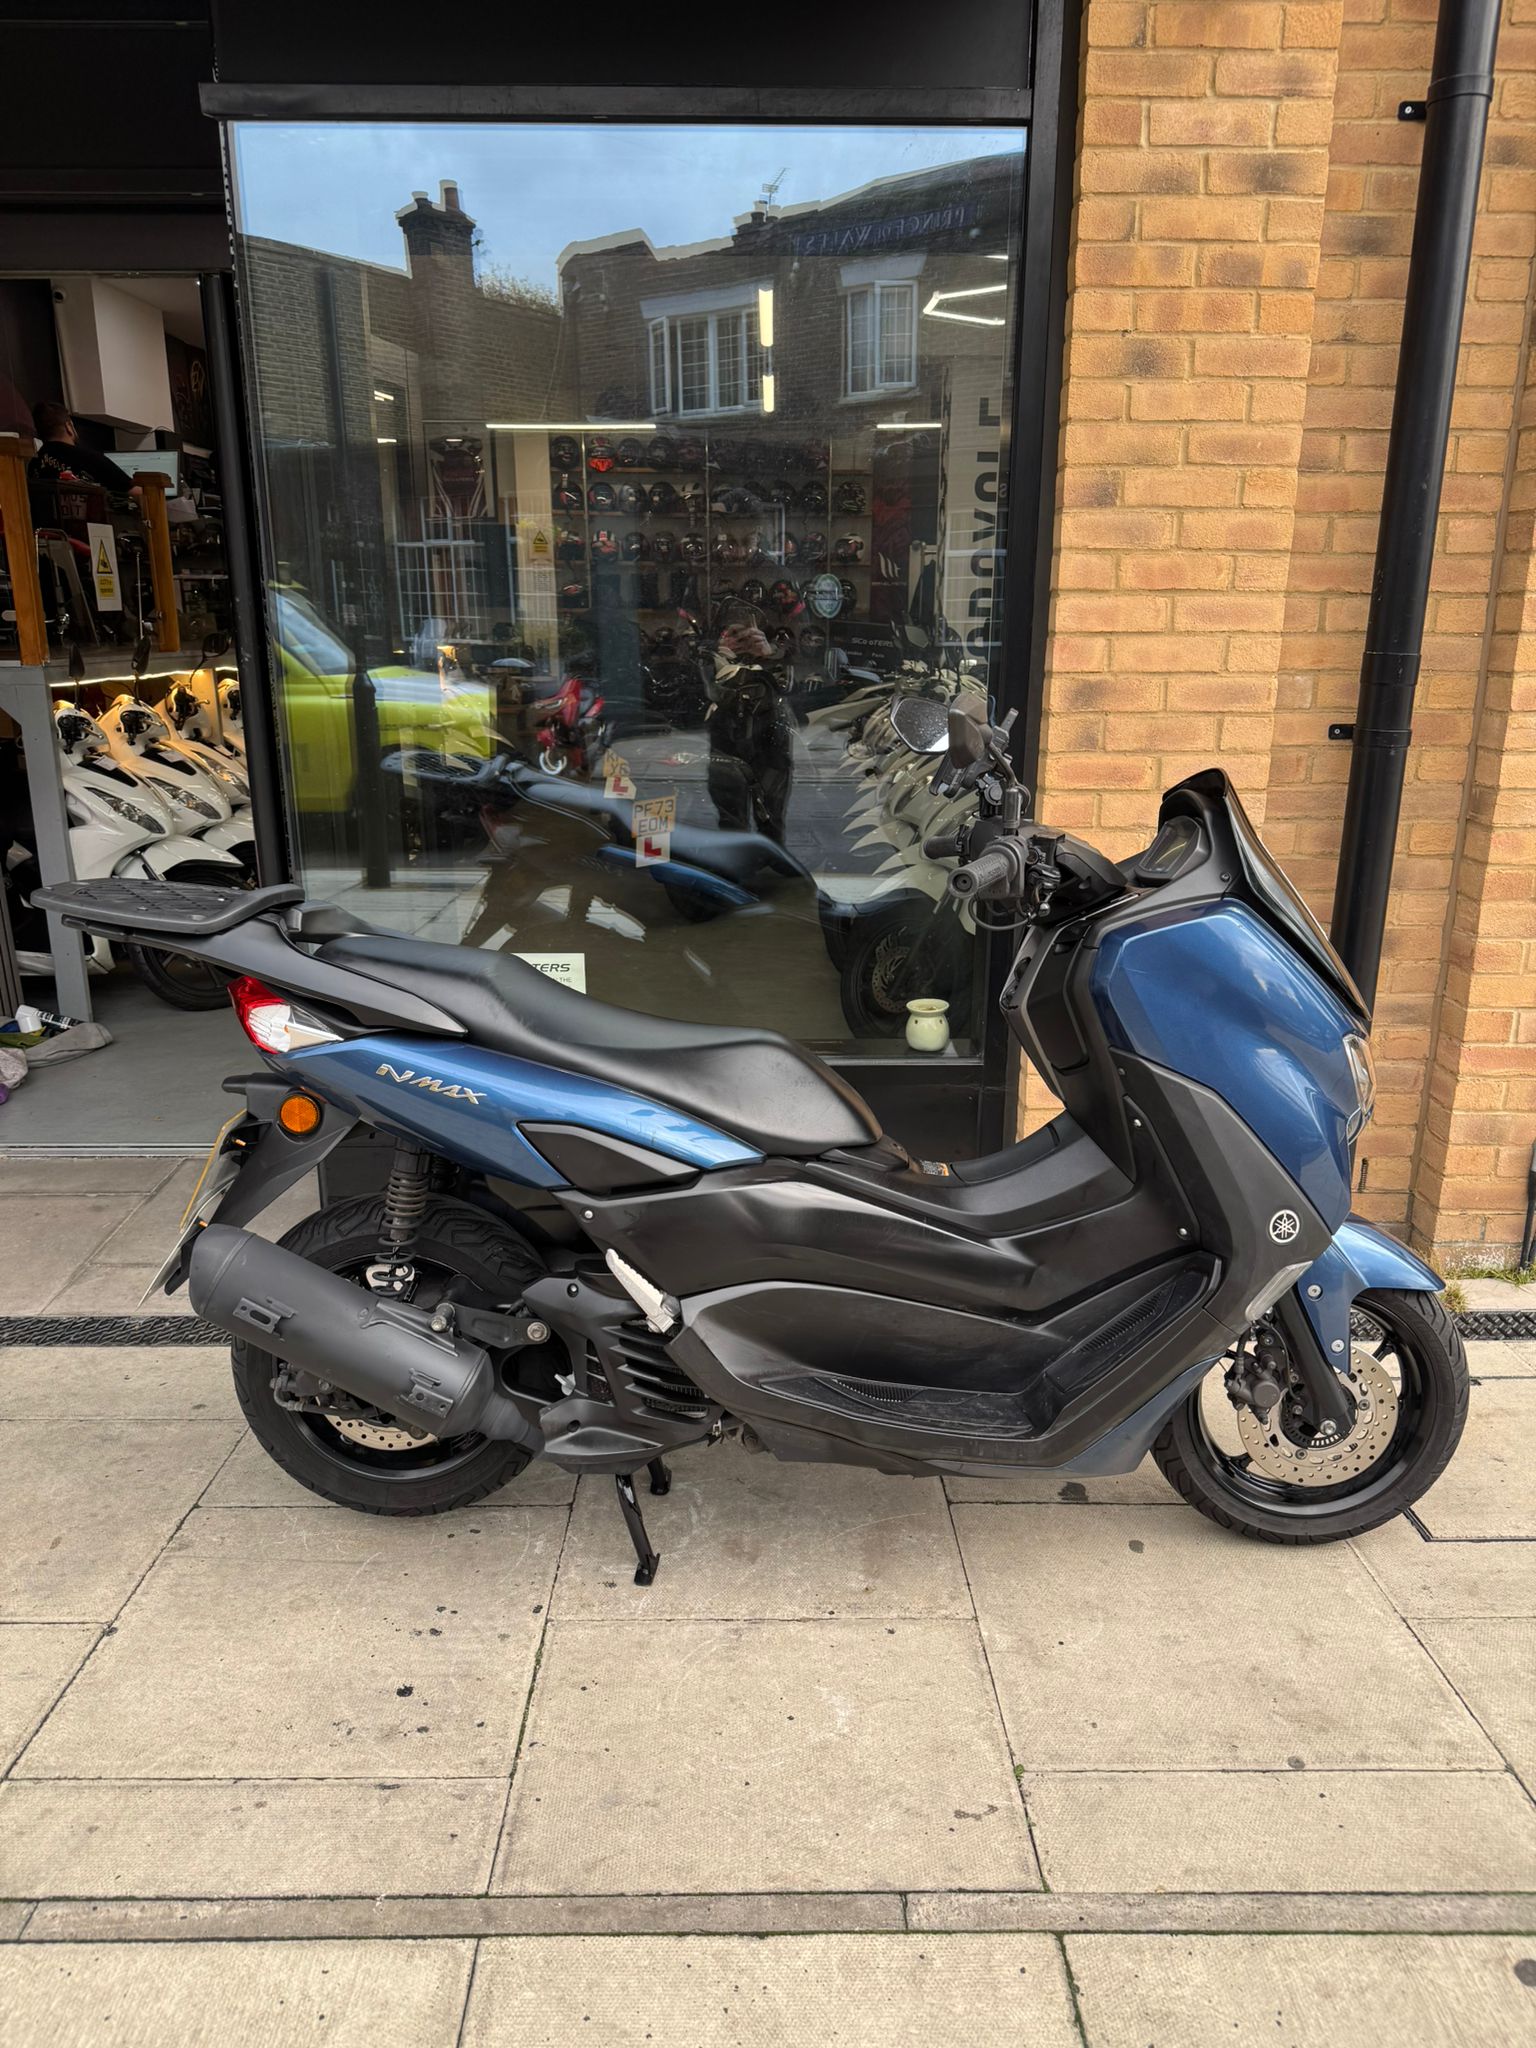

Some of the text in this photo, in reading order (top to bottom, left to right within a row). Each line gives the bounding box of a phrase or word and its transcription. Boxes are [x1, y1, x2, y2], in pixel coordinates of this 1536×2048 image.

[634, 800, 674, 818] PF73
[638, 816, 669, 834] EOM
[644, 836, 662, 857] L
[376, 1063, 487, 1105] NMAX
